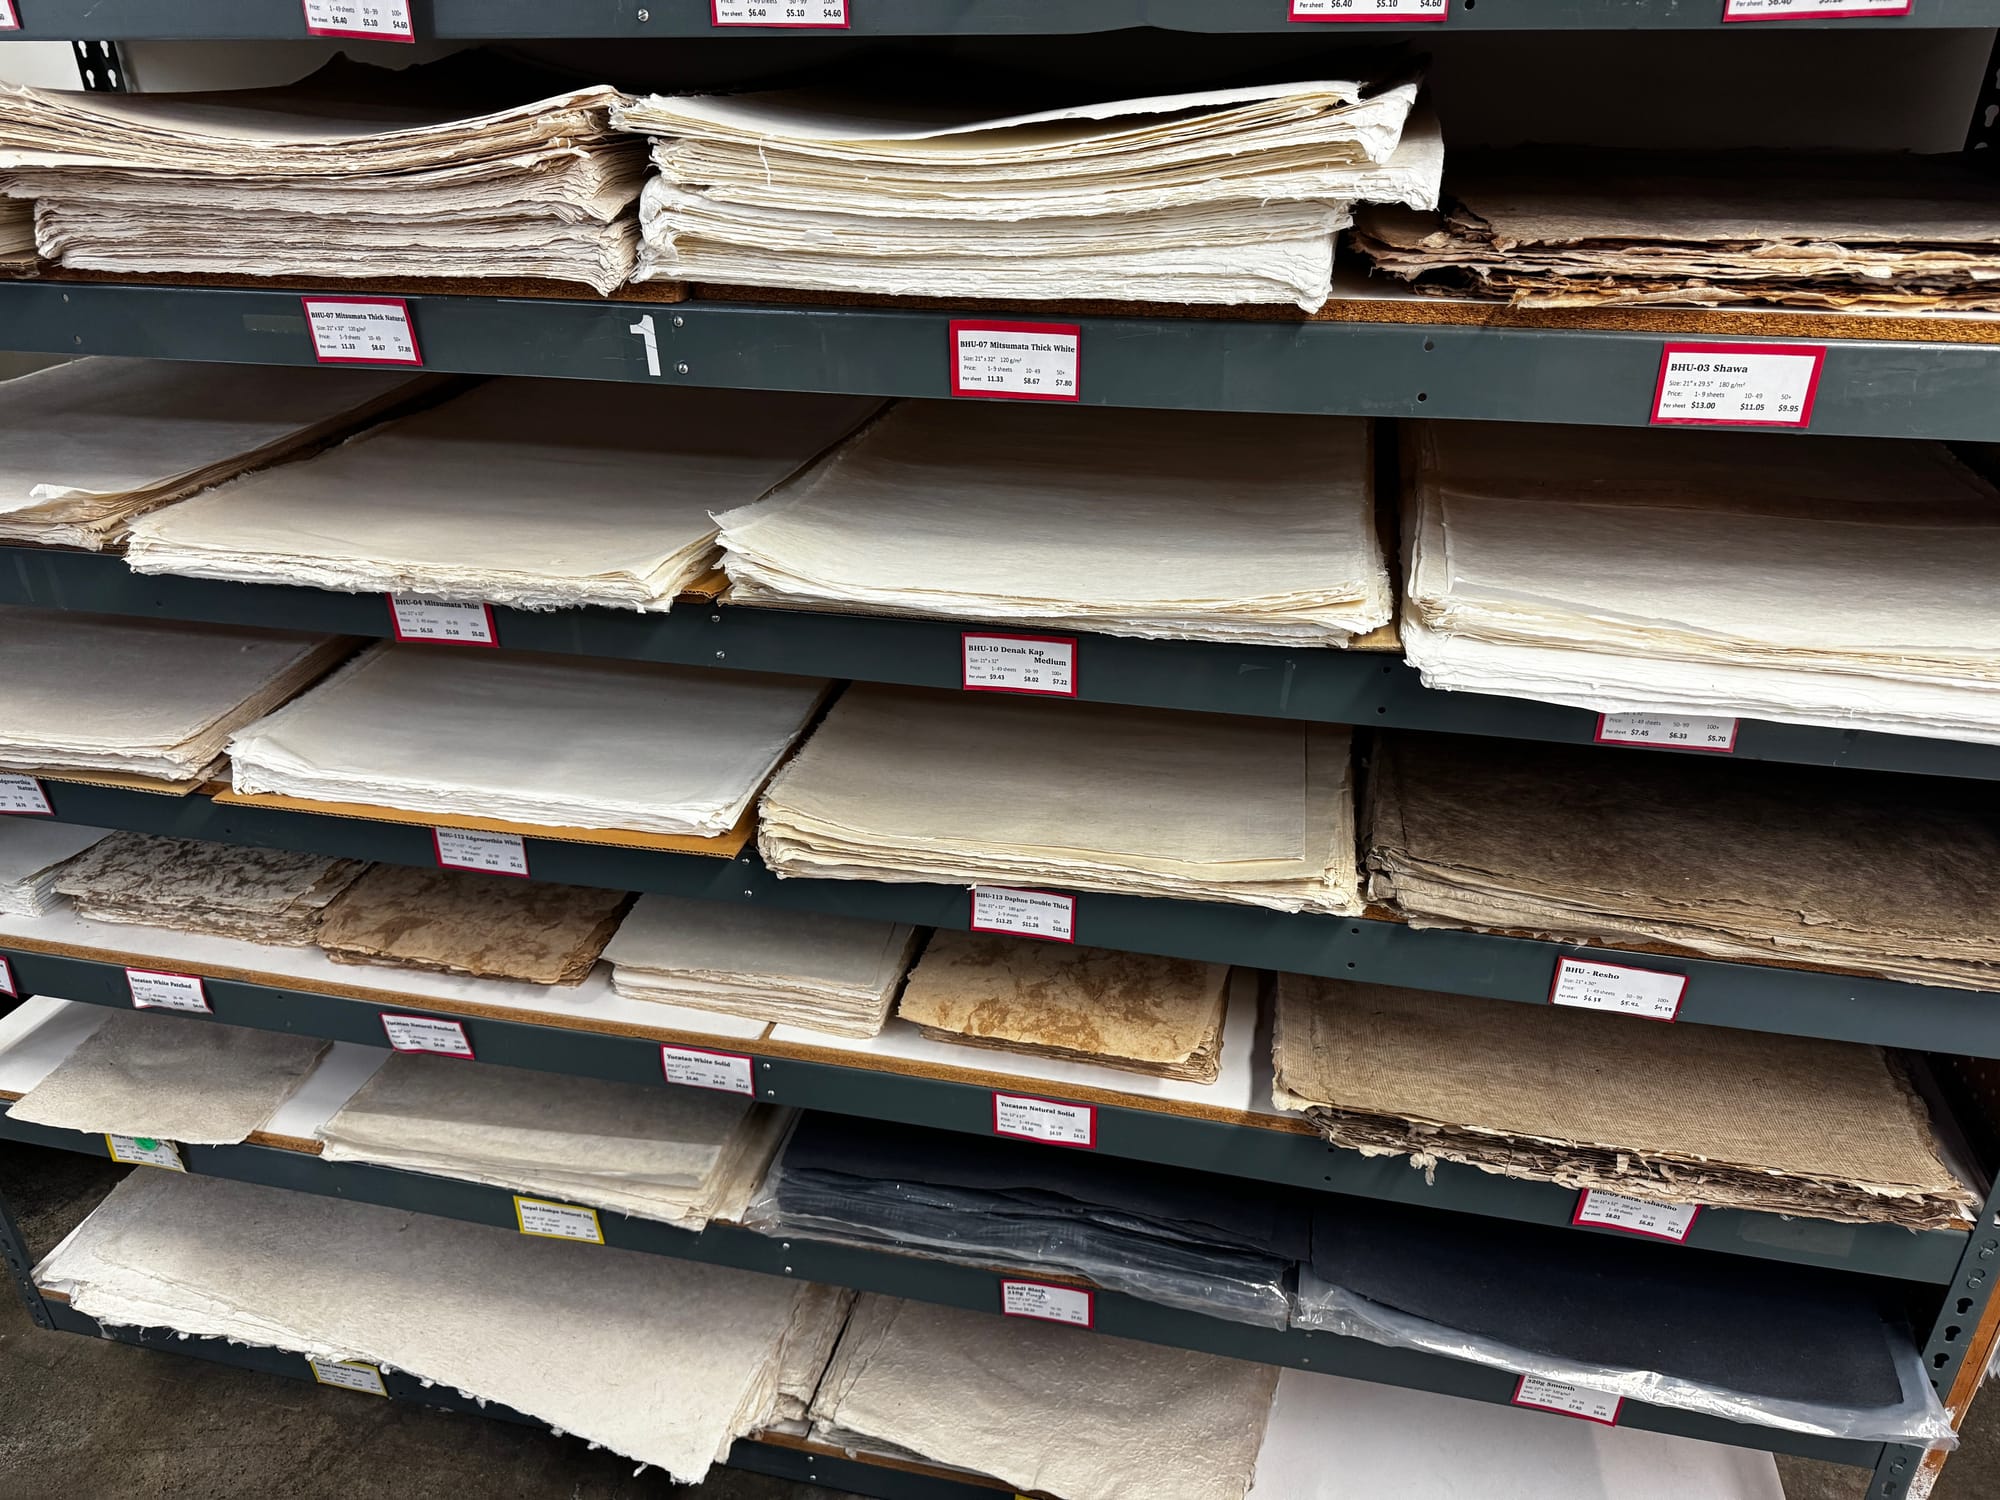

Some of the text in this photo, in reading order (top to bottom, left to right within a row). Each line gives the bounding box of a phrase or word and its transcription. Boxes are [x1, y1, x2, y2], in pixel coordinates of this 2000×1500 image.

[1331, 0, 1352, 8] $6.40
[1377, 0, 1397, 8] $5.10
[748, 9, 766, 17] $6.40
[787, 9, 804, 17] $5.10
[823, 9, 841, 18] $4.60
[332, 16, 347, 24] $6.40
[363, 19, 378, 27] $5.10
[393, 20, 407, 29] $4.60
[335, 312, 367, 320] Mitsumata
[630, 314, 661, 376] 1
[990, 341, 1029, 351] Mitsumata
[1053, 345, 1075, 353] White
[1671, 363, 1748, 373] BHU-03 Shawa
[1055, 379, 1072, 387] $7.80
[1691, 402, 1715, 410] $13.00
[1740, 403, 1764, 411] $11.05
[1778, 404, 1799, 412] $9.95
[424, 600, 462, 608] Mitsumata
[1028, 648, 1044, 656] Kap
[1034, 657, 1067, 666] Medium
[1052, 678, 1067, 686] $7.22
[1630, 728, 1649, 737] $7.45
[1669, 732, 1687, 740] $6.33
[1707, 734, 1726, 743] $5.70
[976, 892, 1069, 910] BHU-113 Daphne Double Thick
[1565, 966, 1620, 980] BHU Resho
[667, 1054, 692, 1062] Yucatan
[1000, 1101, 1028, 1110] Yucatan
[1029, 1105, 1056, 1114] Natural
[1546, 1381, 1576, 1392] Smooth
